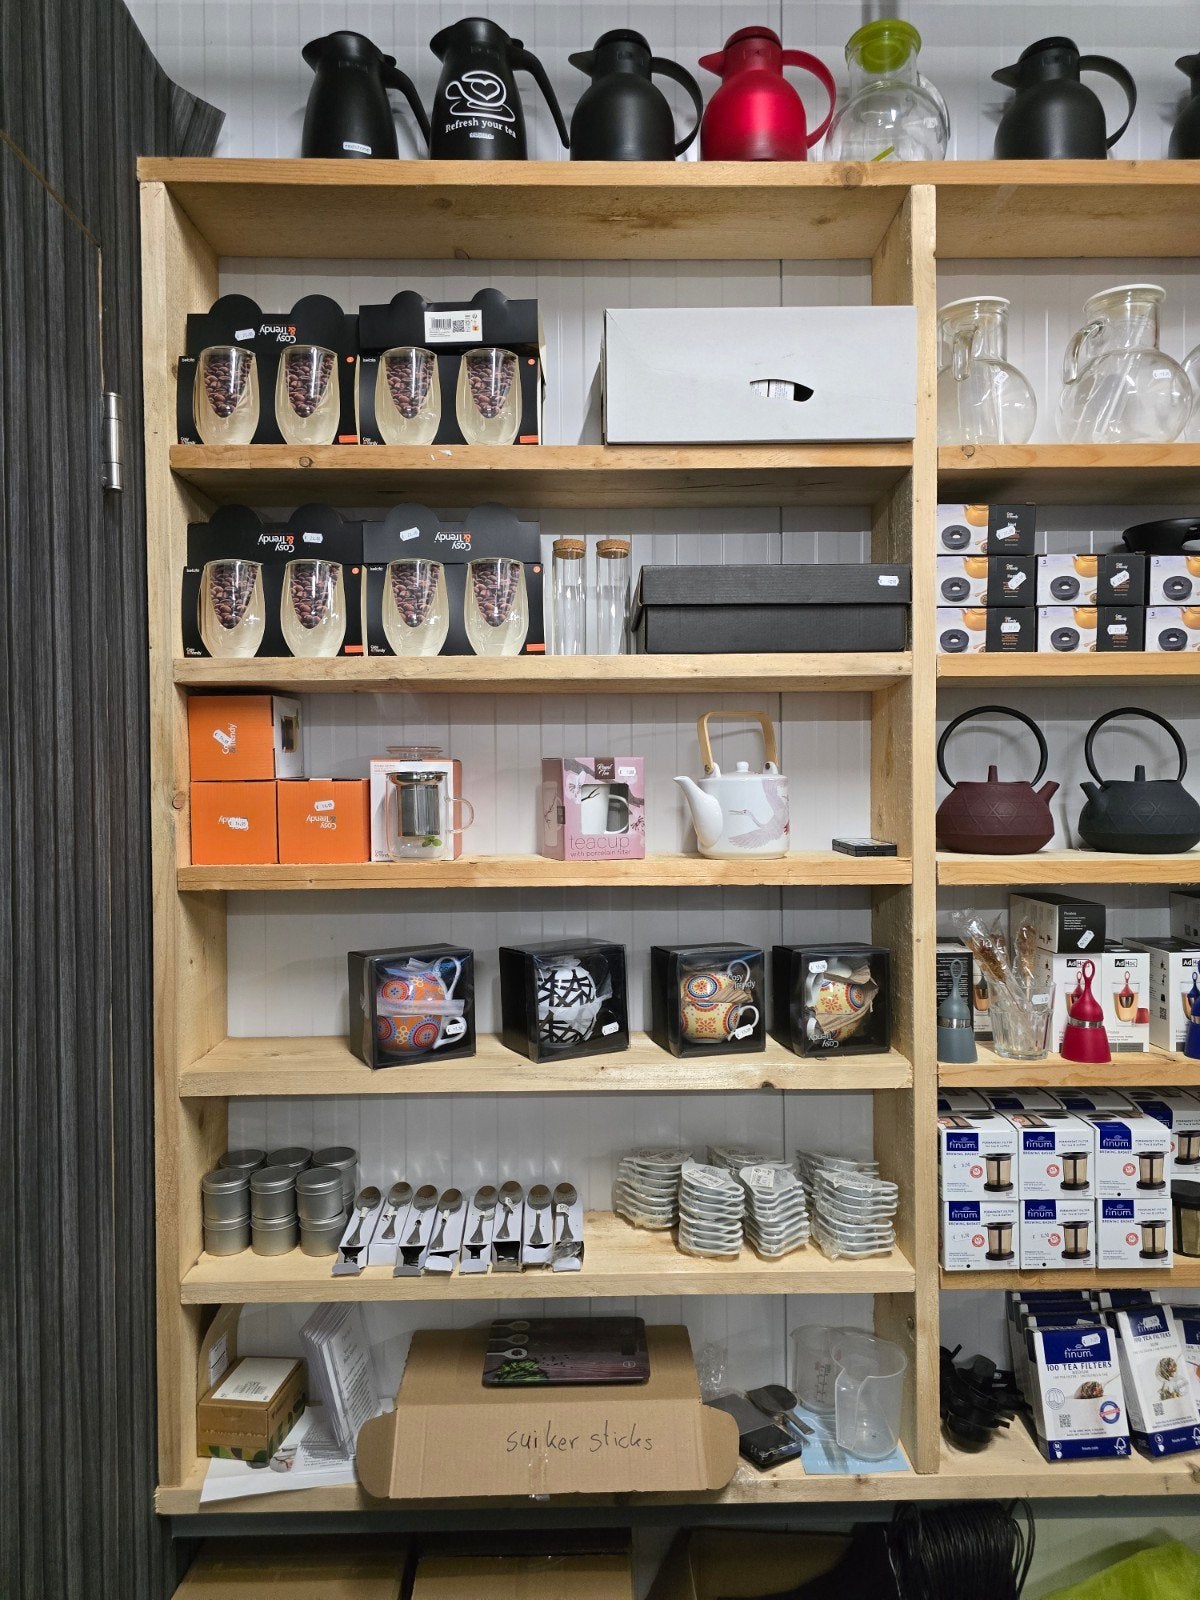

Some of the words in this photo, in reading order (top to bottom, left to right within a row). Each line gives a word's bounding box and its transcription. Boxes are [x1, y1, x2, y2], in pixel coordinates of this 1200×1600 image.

[444, 117, 479, 134] Refresh
[482, 120, 504, 130] your
[504, 126, 517, 138] tea
[276, 334, 296, 344] Cosy
[274, 544, 295, 552] Cosy
[452, 542, 472, 551] Cosy
[320, 822, 336, 830] Cosy
[569, 835, 630, 850] teacup
[822, 1040, 839, 1048] Cosy
[949, 1140, 976, 1149] finum
[1026, 1139, 1053, 1148] finum
[1102, 1138, 1129, 1147] finum
[951, 1210, 978, 1219] finum
[1027, 1208, 1054, 1217] finum
[1105, 1207, 1130, 1216] finum
[1064, 1348, 1092, 1358] finum
[1081, 1361, 1112, 1370] FILTERS
[506, 1420, 580, 1452] suiker
[589, 1420, 653, 1452] sticks
